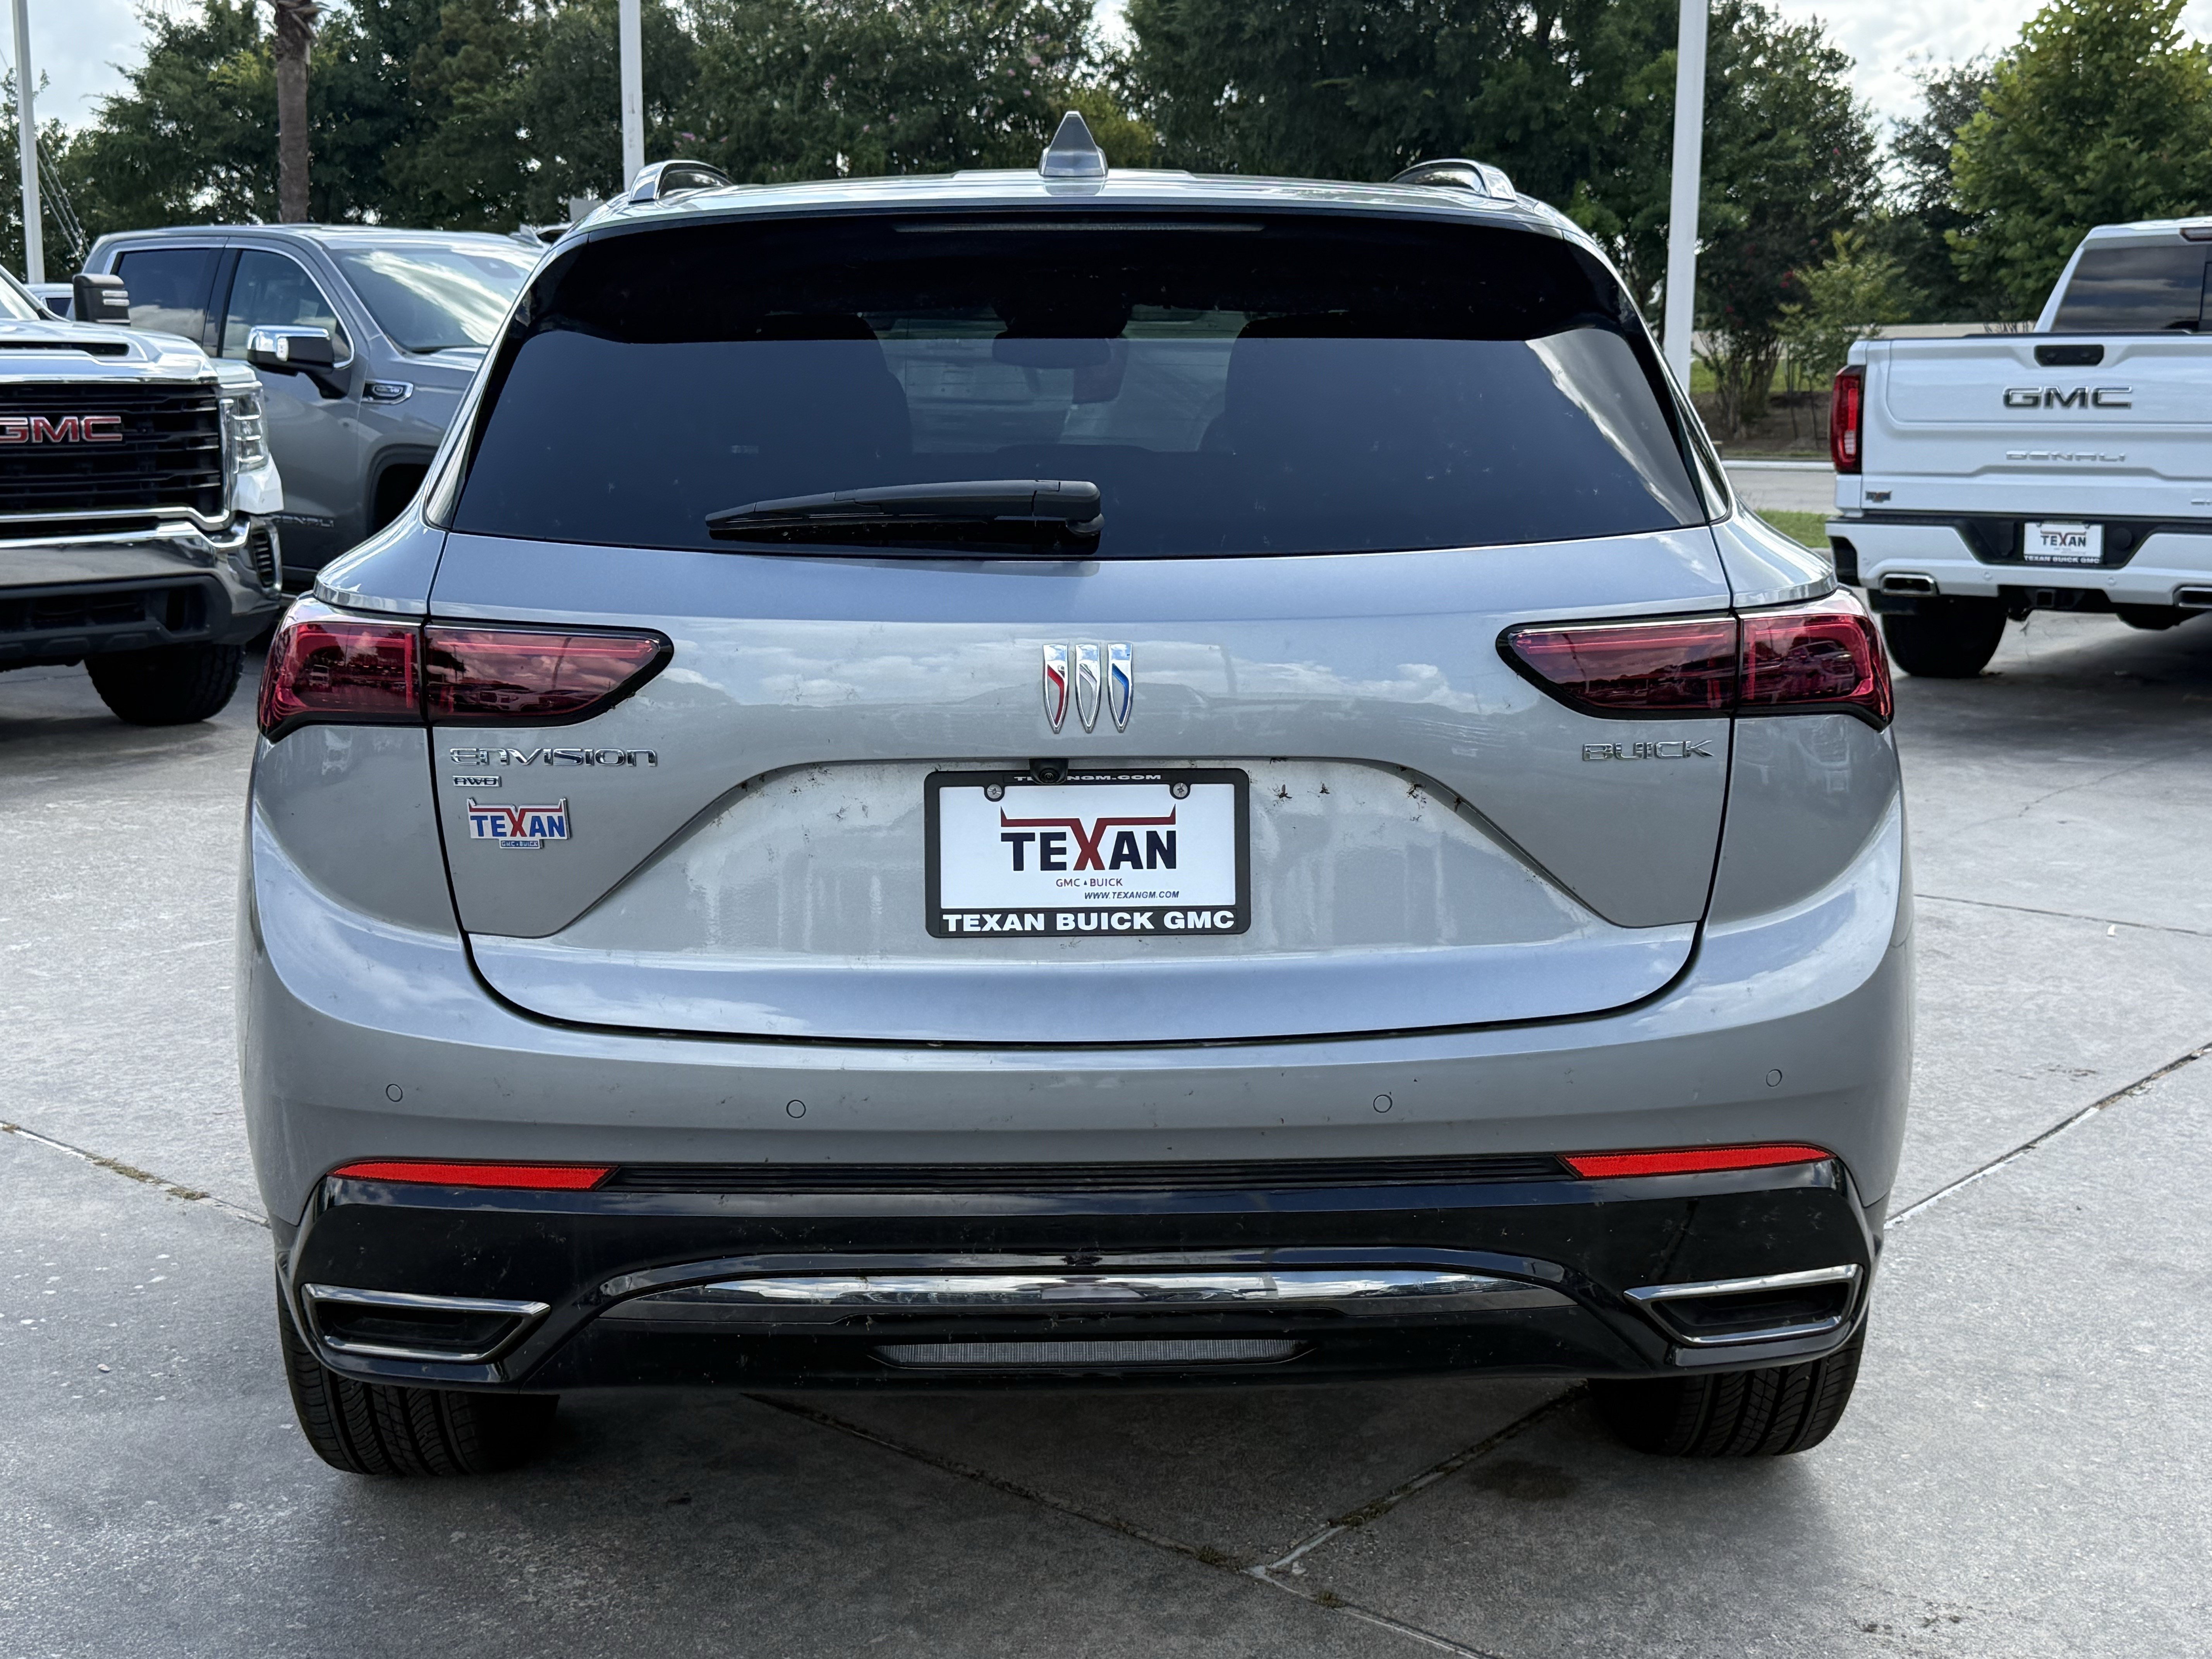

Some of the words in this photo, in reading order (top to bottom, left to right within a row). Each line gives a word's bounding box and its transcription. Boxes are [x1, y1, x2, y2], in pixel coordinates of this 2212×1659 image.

[2003, 386, 2132, 409] GMC
[0, 416, 123, 443] GMC
[2006, 450, 2126, 462] DENALI
[2040, 532, 2086, 547] TEXAN
[1583, 740, 1714, 761] BUICK
[469, 808, 565, 837] TEXAN
[1001, 817, 1176, 871] TEXAN
[1056, 878, 1080, 887] GMC
[1090, 878, 1123, 887] BUICK
[1084, 891, 1180, 899] WWW.TEXANGM.COM
[943, 914, 1045, 932] TEXAN
[1056, 912, 1154, 931] BUICK
[1163, 911, 1235, 929] GMC
